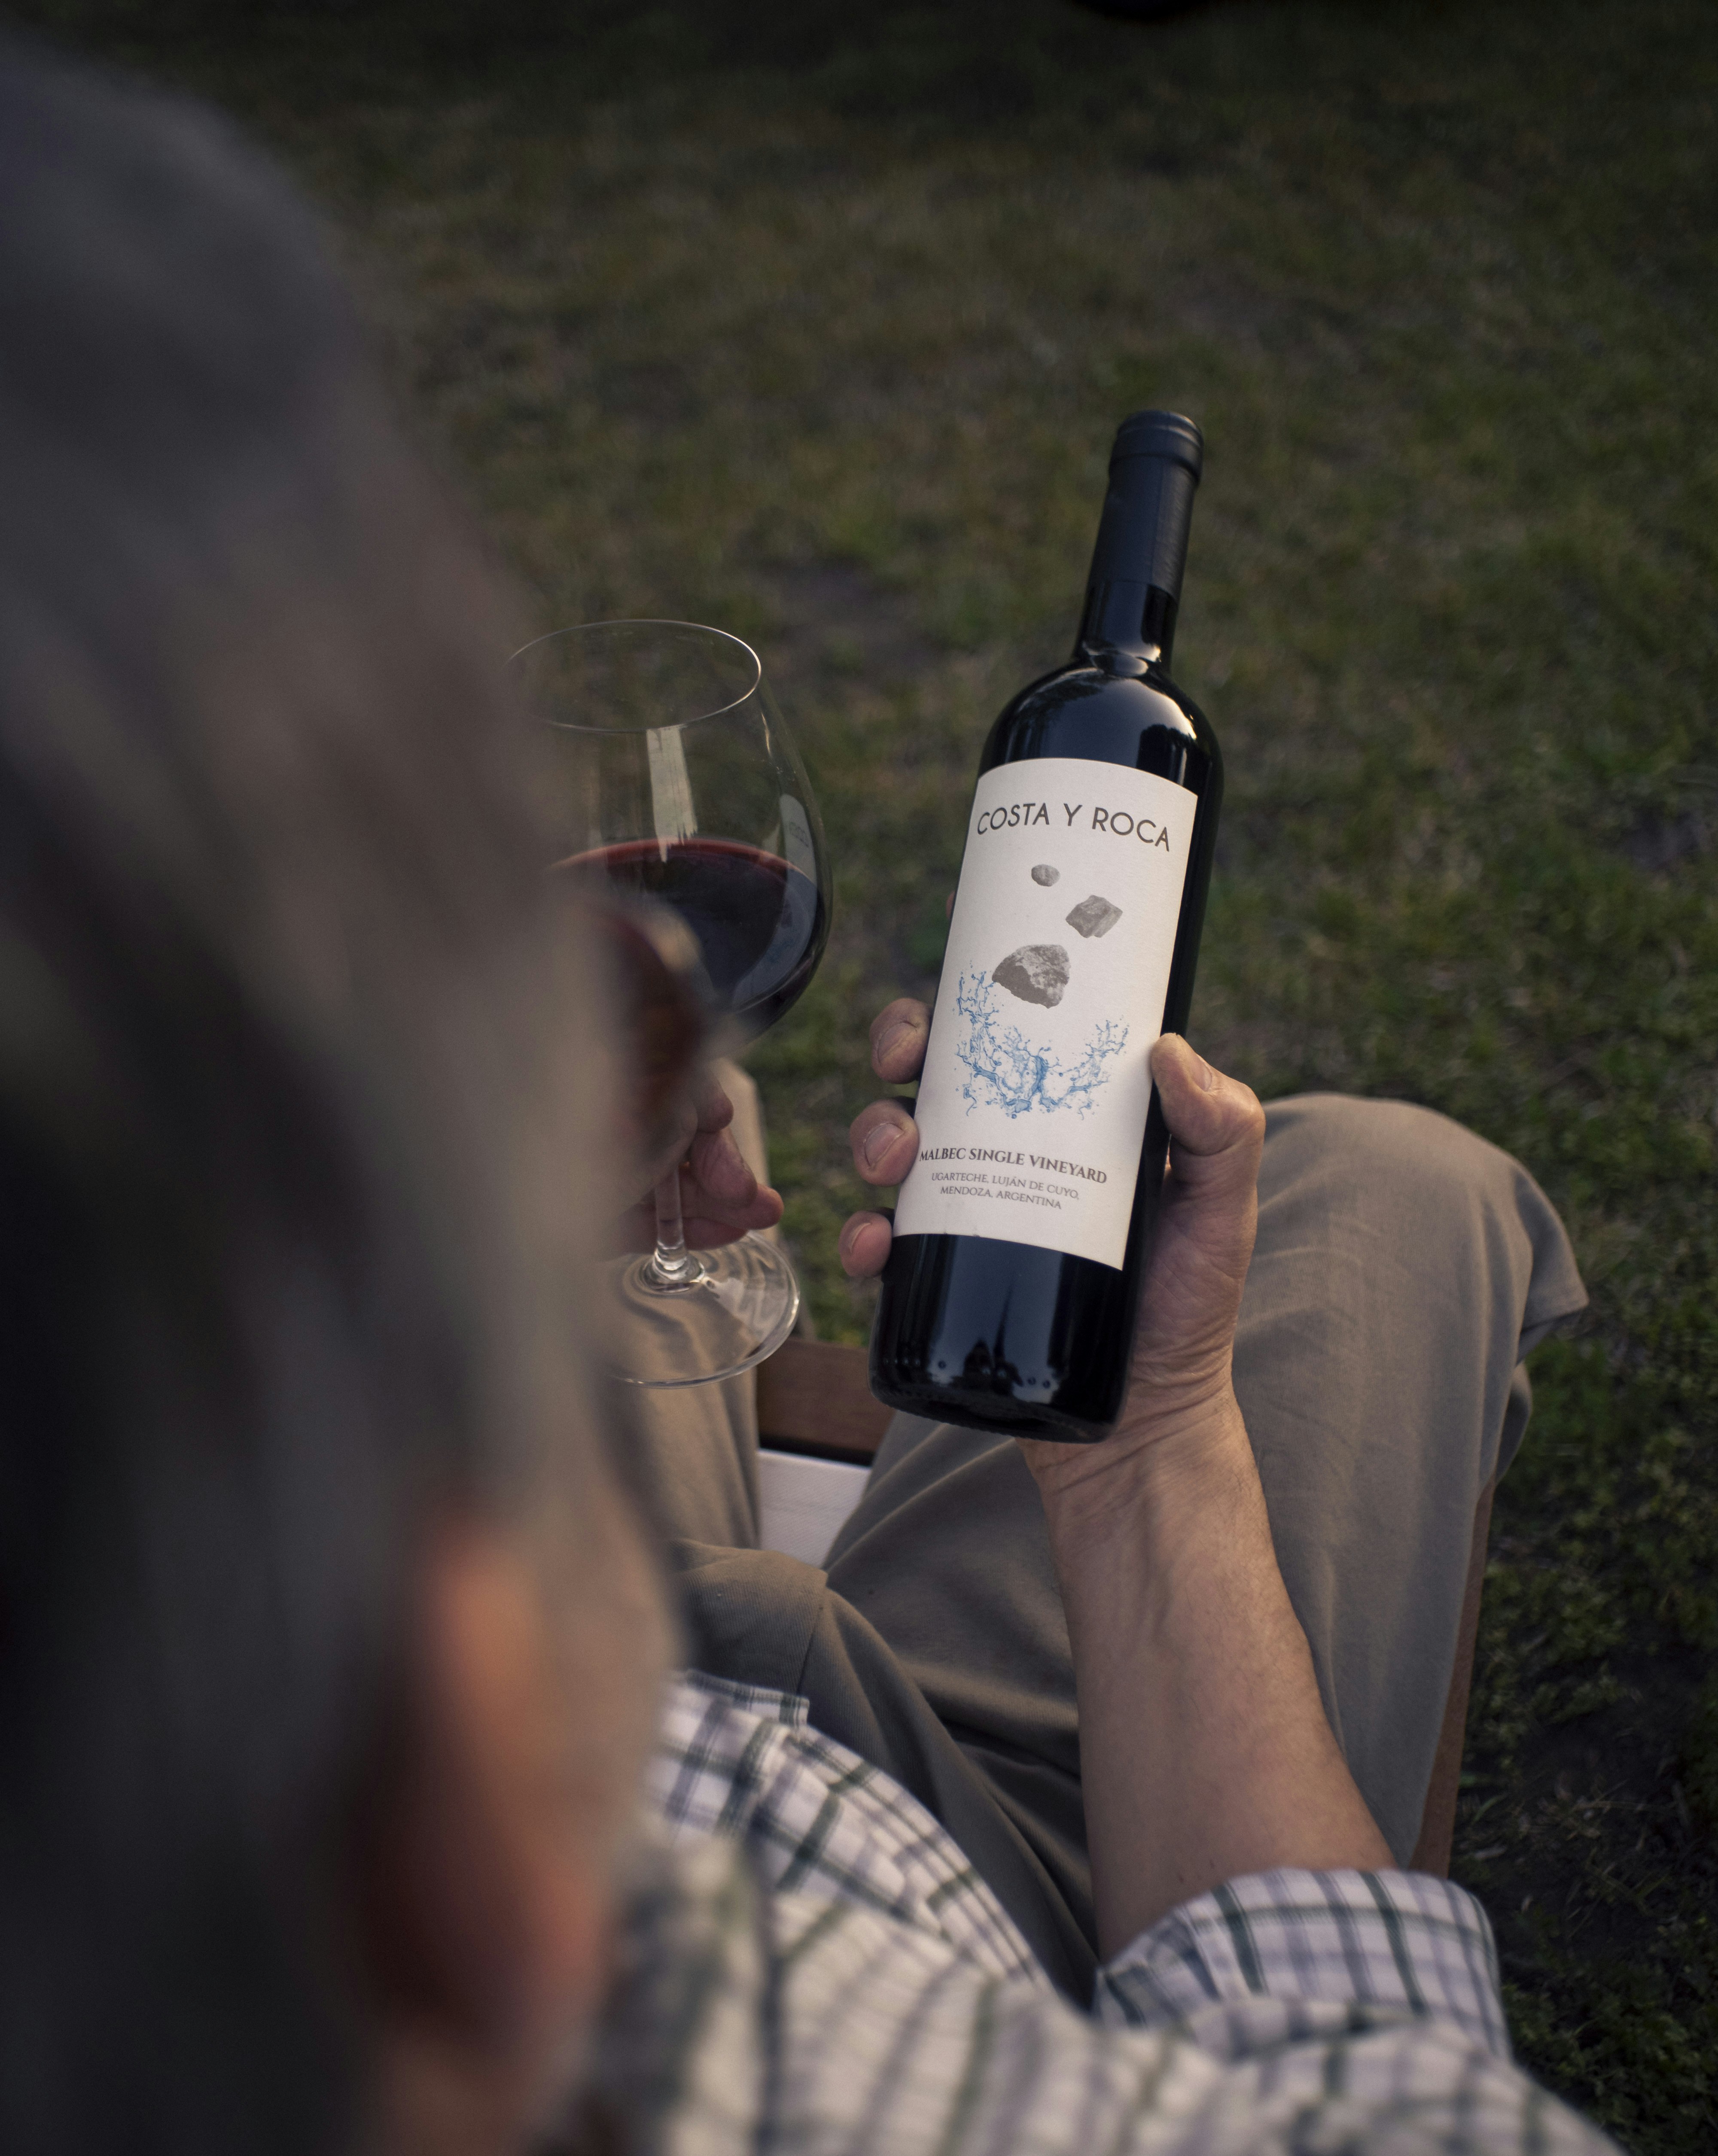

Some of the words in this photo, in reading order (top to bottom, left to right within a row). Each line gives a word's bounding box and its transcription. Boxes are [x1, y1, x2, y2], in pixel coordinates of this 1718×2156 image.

[977, 803, 1050, 835] COSTA
[1064, 803, 1082, 826] Y
[1092, 807, 1169, 851] ROCA
[920, 1148, 966, 1161] MALBEC
[969, 1149, 1025, 1165] SINGLE
[1030, 1155, 1107, 1184] VINEYARD
[932, 1173, 989, 1183] UGARTECHE,
[992, 1175, 1026, 1188] LUJÁN
[1030, 1181, 1044, 1191] DE
[1047, 1185, 1079, 1200] CUYO,
[940, 1186, 993, 1198] MENDOZA,
[996, 1191, 1061, 1209] ARGENTINA
